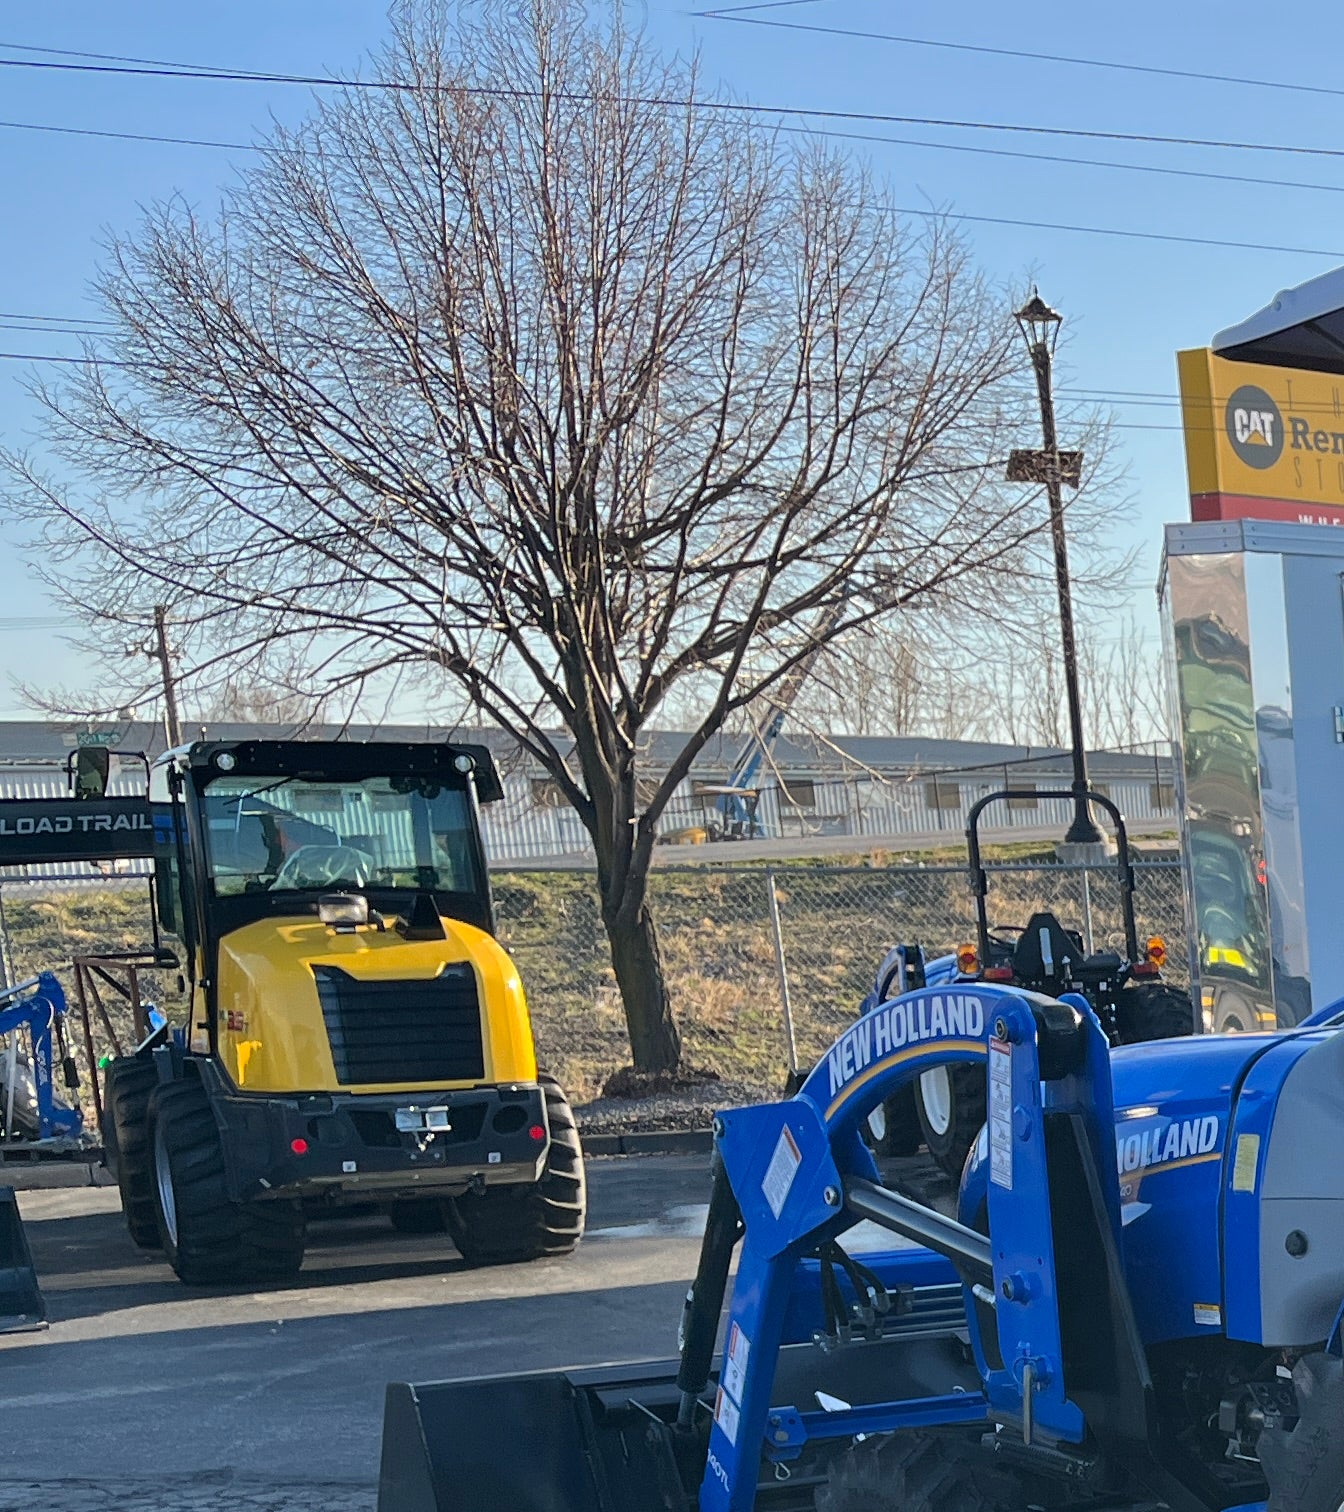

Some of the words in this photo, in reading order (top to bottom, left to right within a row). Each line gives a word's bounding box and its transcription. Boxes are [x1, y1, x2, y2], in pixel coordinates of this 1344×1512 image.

[1234, 408, 1274, 447] CAT
[0, 816, 73, 835] LOAD
[77, 814, 152, 832] TRAIL
[828, 1019, 871, 1098] NEW
[874, 995, 984, 1058] HOLLAND
